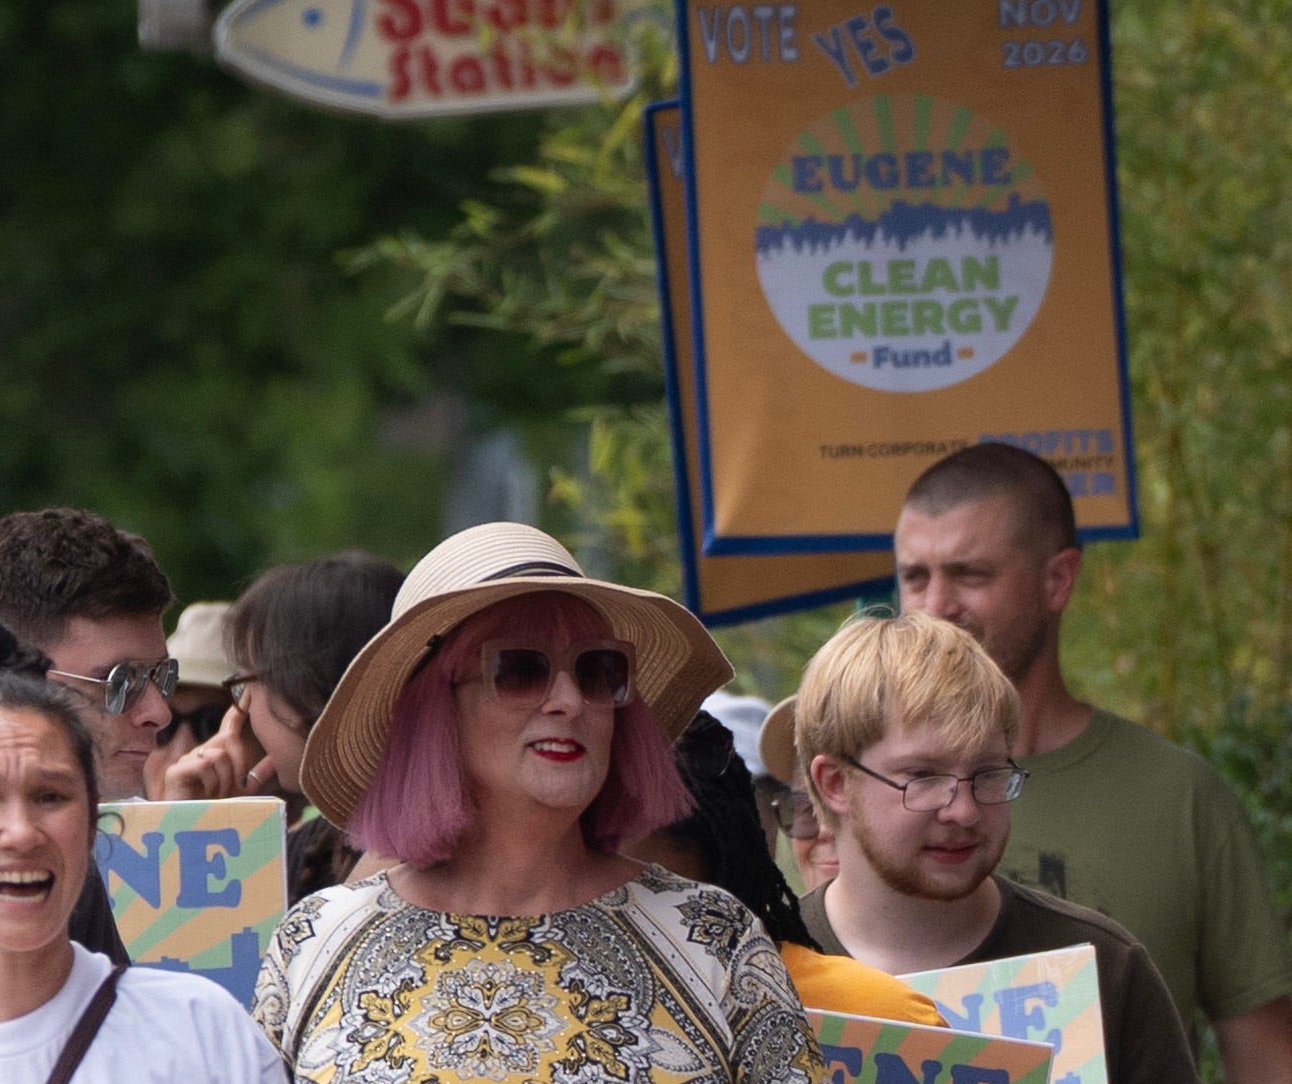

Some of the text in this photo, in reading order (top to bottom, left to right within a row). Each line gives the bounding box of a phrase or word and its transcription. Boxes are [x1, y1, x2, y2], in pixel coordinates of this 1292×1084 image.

[997, 0, 1082, 29] NOV
[700, 5, 916, 87] VOTE YES
[1002, 38, 1088, 68] 2026
[792, 146, 1013, 194] EUGENE
[822, 255, 1001, 297] CLEAN
[807, 296, 1019, 341] ENERGY
[873, 341, 954, 369] Fund
[820, 444, 863, 458] TURN
[978, 429, 1113, 456] OFITS
